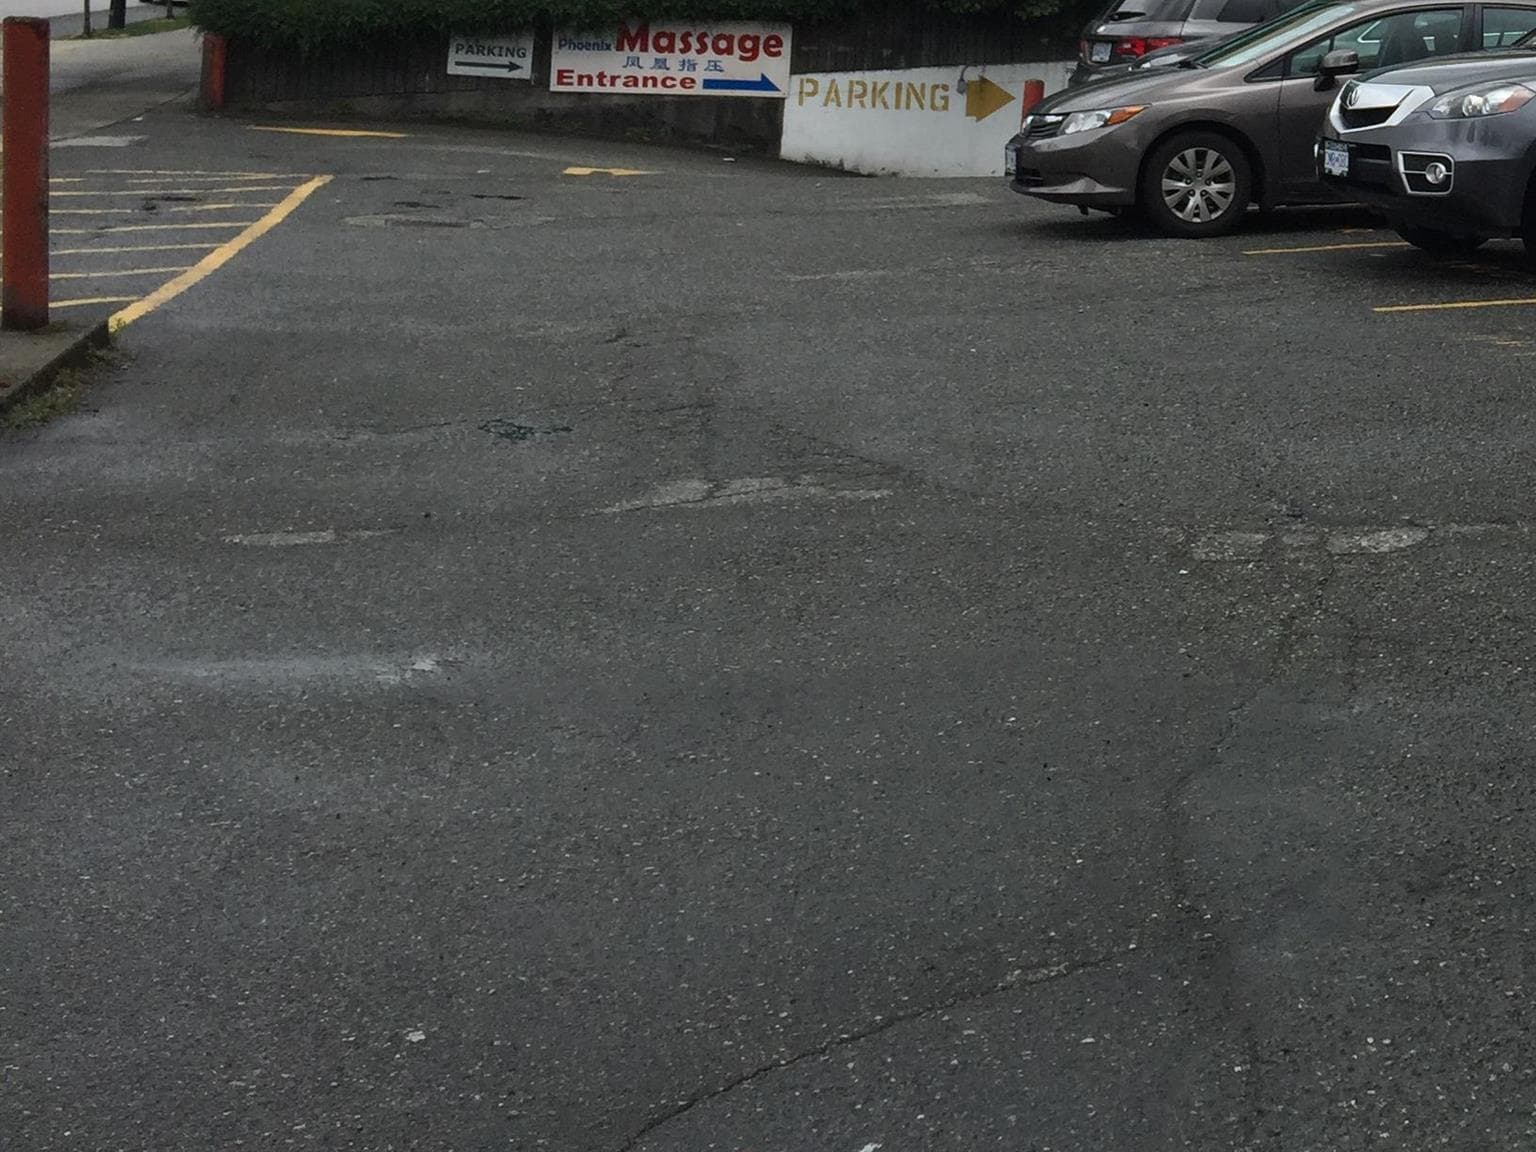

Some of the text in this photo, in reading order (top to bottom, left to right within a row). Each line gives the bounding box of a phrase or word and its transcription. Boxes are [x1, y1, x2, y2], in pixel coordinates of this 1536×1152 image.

[454, 42, 527, 59] PARKING
[558, 25, 784, 62] Phoenix Massage
[556, 69, 697, 90] Entrance
[798, 77, 950, 111] PARKING
